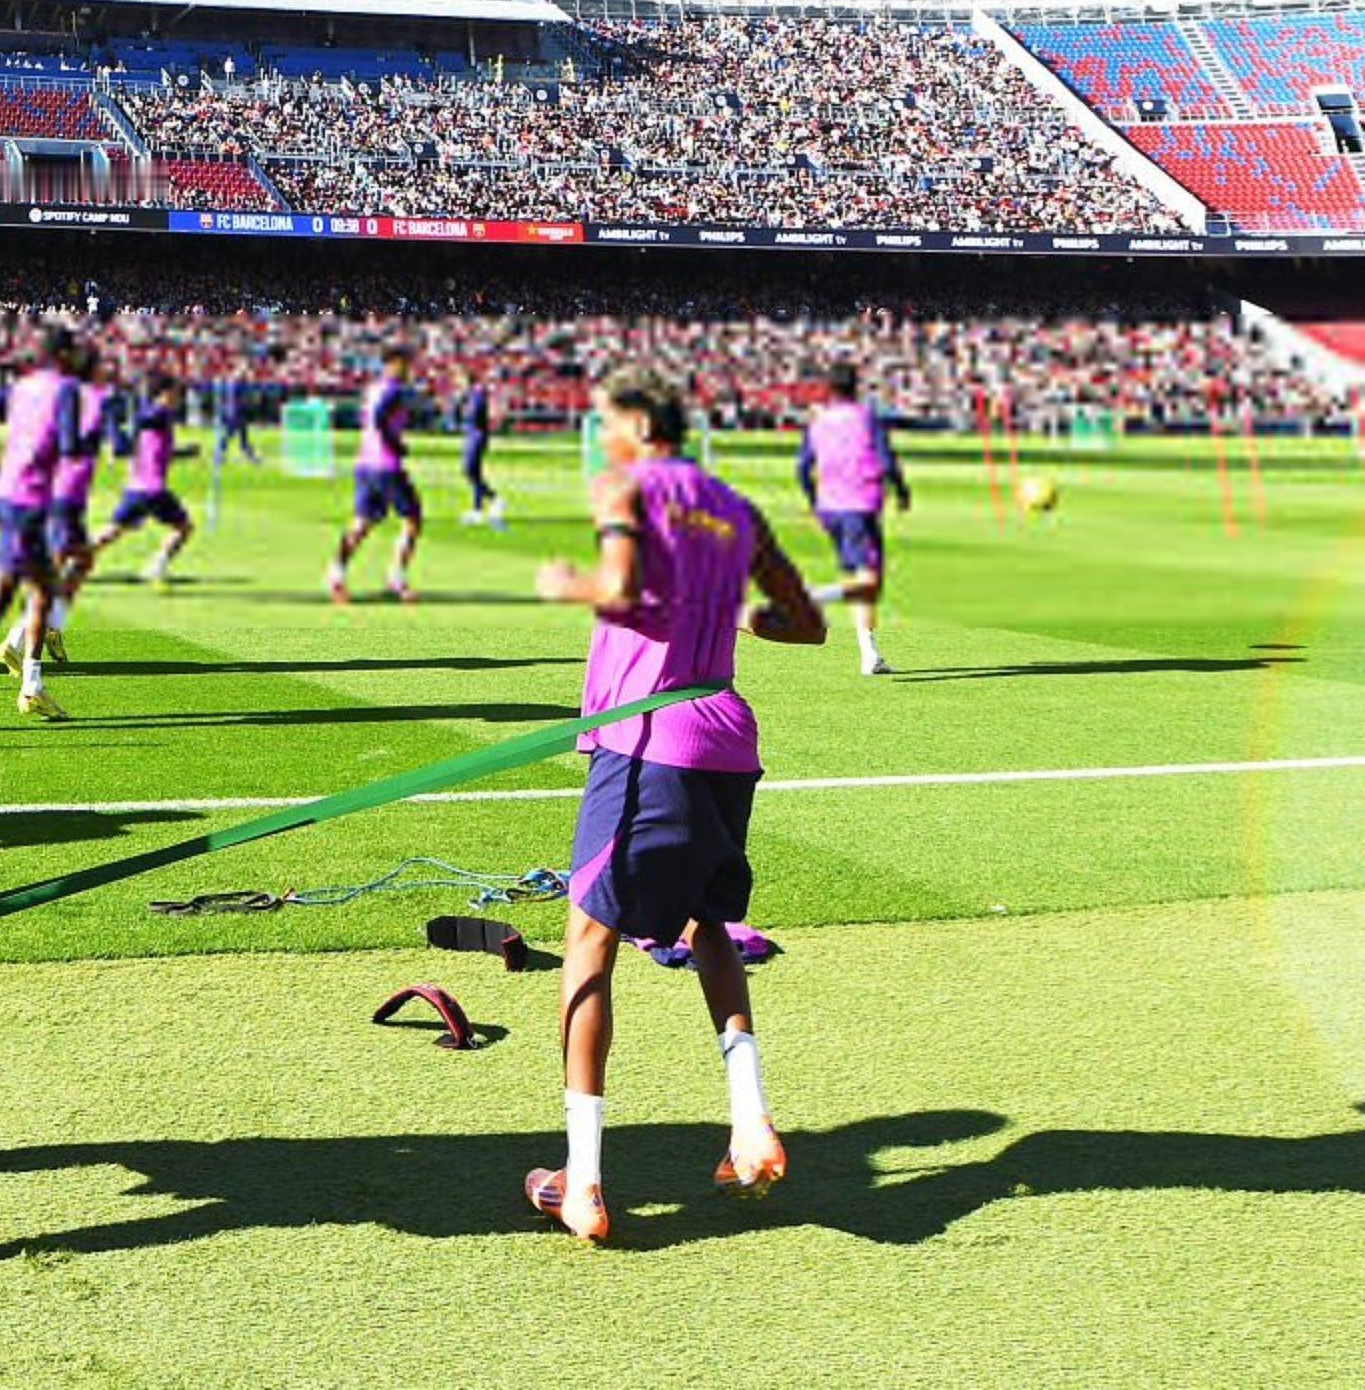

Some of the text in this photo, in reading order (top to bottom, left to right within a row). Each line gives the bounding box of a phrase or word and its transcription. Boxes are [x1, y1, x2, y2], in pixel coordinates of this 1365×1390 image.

[42, 211, 81, 223] SPOTIFY
[218, 213, 294, 231] FC BARCELONA
[312, 216, 324, 233] 0
[366, 218, 378, 235] 0
[393, 218, 468, 237] FC BARCELONA
